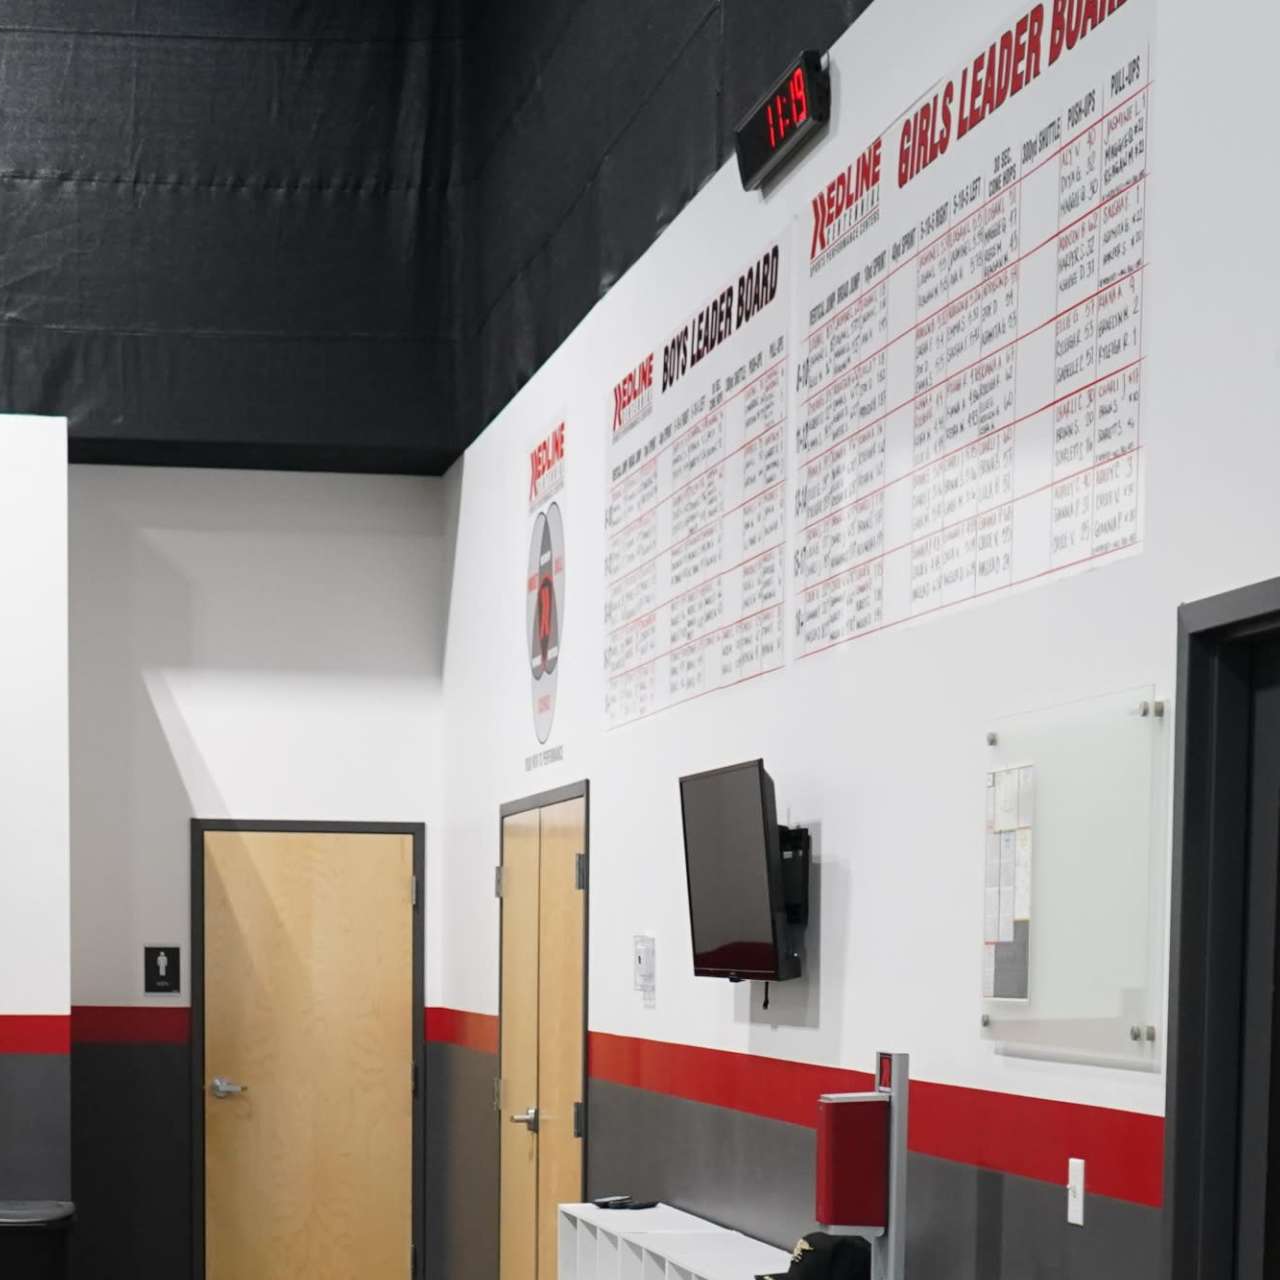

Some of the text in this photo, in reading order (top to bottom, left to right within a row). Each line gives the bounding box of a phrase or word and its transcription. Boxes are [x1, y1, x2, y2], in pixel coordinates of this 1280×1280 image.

[898, 0, 1129, 190] GIRLS LEADER BOA
[1111, 55, 1140, 98] PULL-UPS
[1067, 89, 1095, 130] PUSH-UPS
[1039, 116, 1061, 152] SHUTTLE
[662, 325, 689, 394] BOYS
[690, 285, 734, 368] LEADER
[735, 244, 779, 330] BOARD
